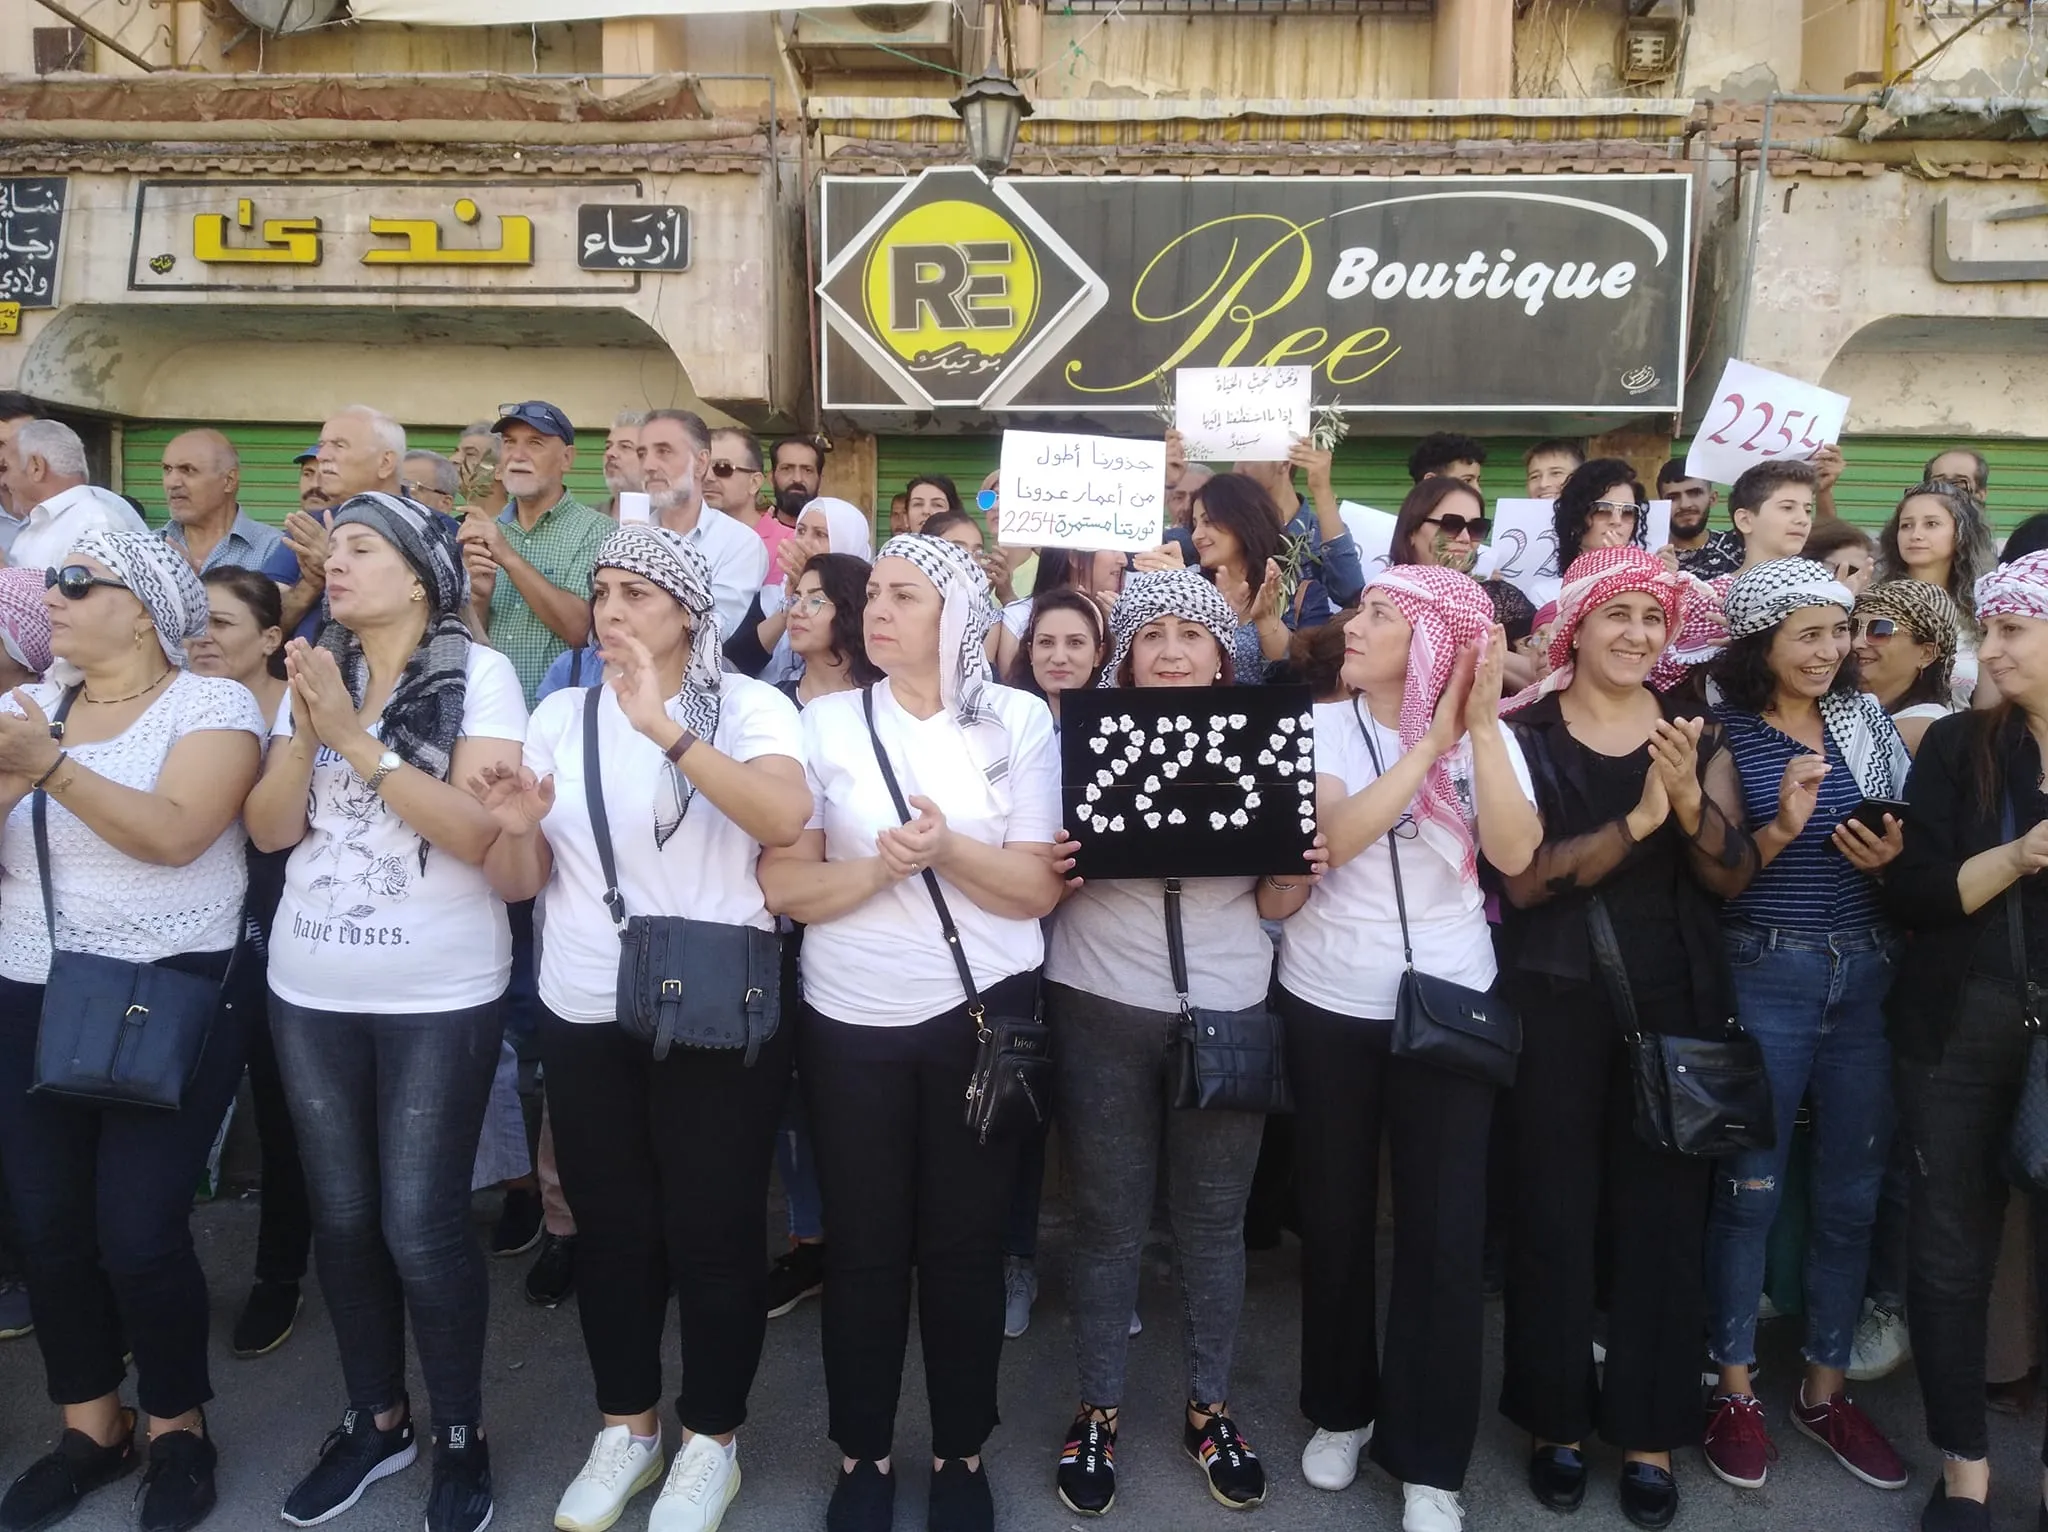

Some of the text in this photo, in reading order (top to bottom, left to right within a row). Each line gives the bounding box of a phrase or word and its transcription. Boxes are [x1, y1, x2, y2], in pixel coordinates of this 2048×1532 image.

[888, 240, 1013, 332] RE
[1327, 247, 1637, 316] Boutique
[1065, 214, 1401, 392] Ree
[908, 347, 1001, 375] بوتيك
[1706, 393, 1824, 461] 2254
[1036, 443, 1080, 468] أطول
[1092, 440, 1154, 472] جذورنا
[1017, 477, 1155, 507] من أعمار عدونا
[1001, 510, 1155, 541] ثورتنا مستمرة 2254
[1499, 528, 1560, 578] 22
[1076, 712, 1316, 834] 2254
[293, 911, 410, 945] have roses.
